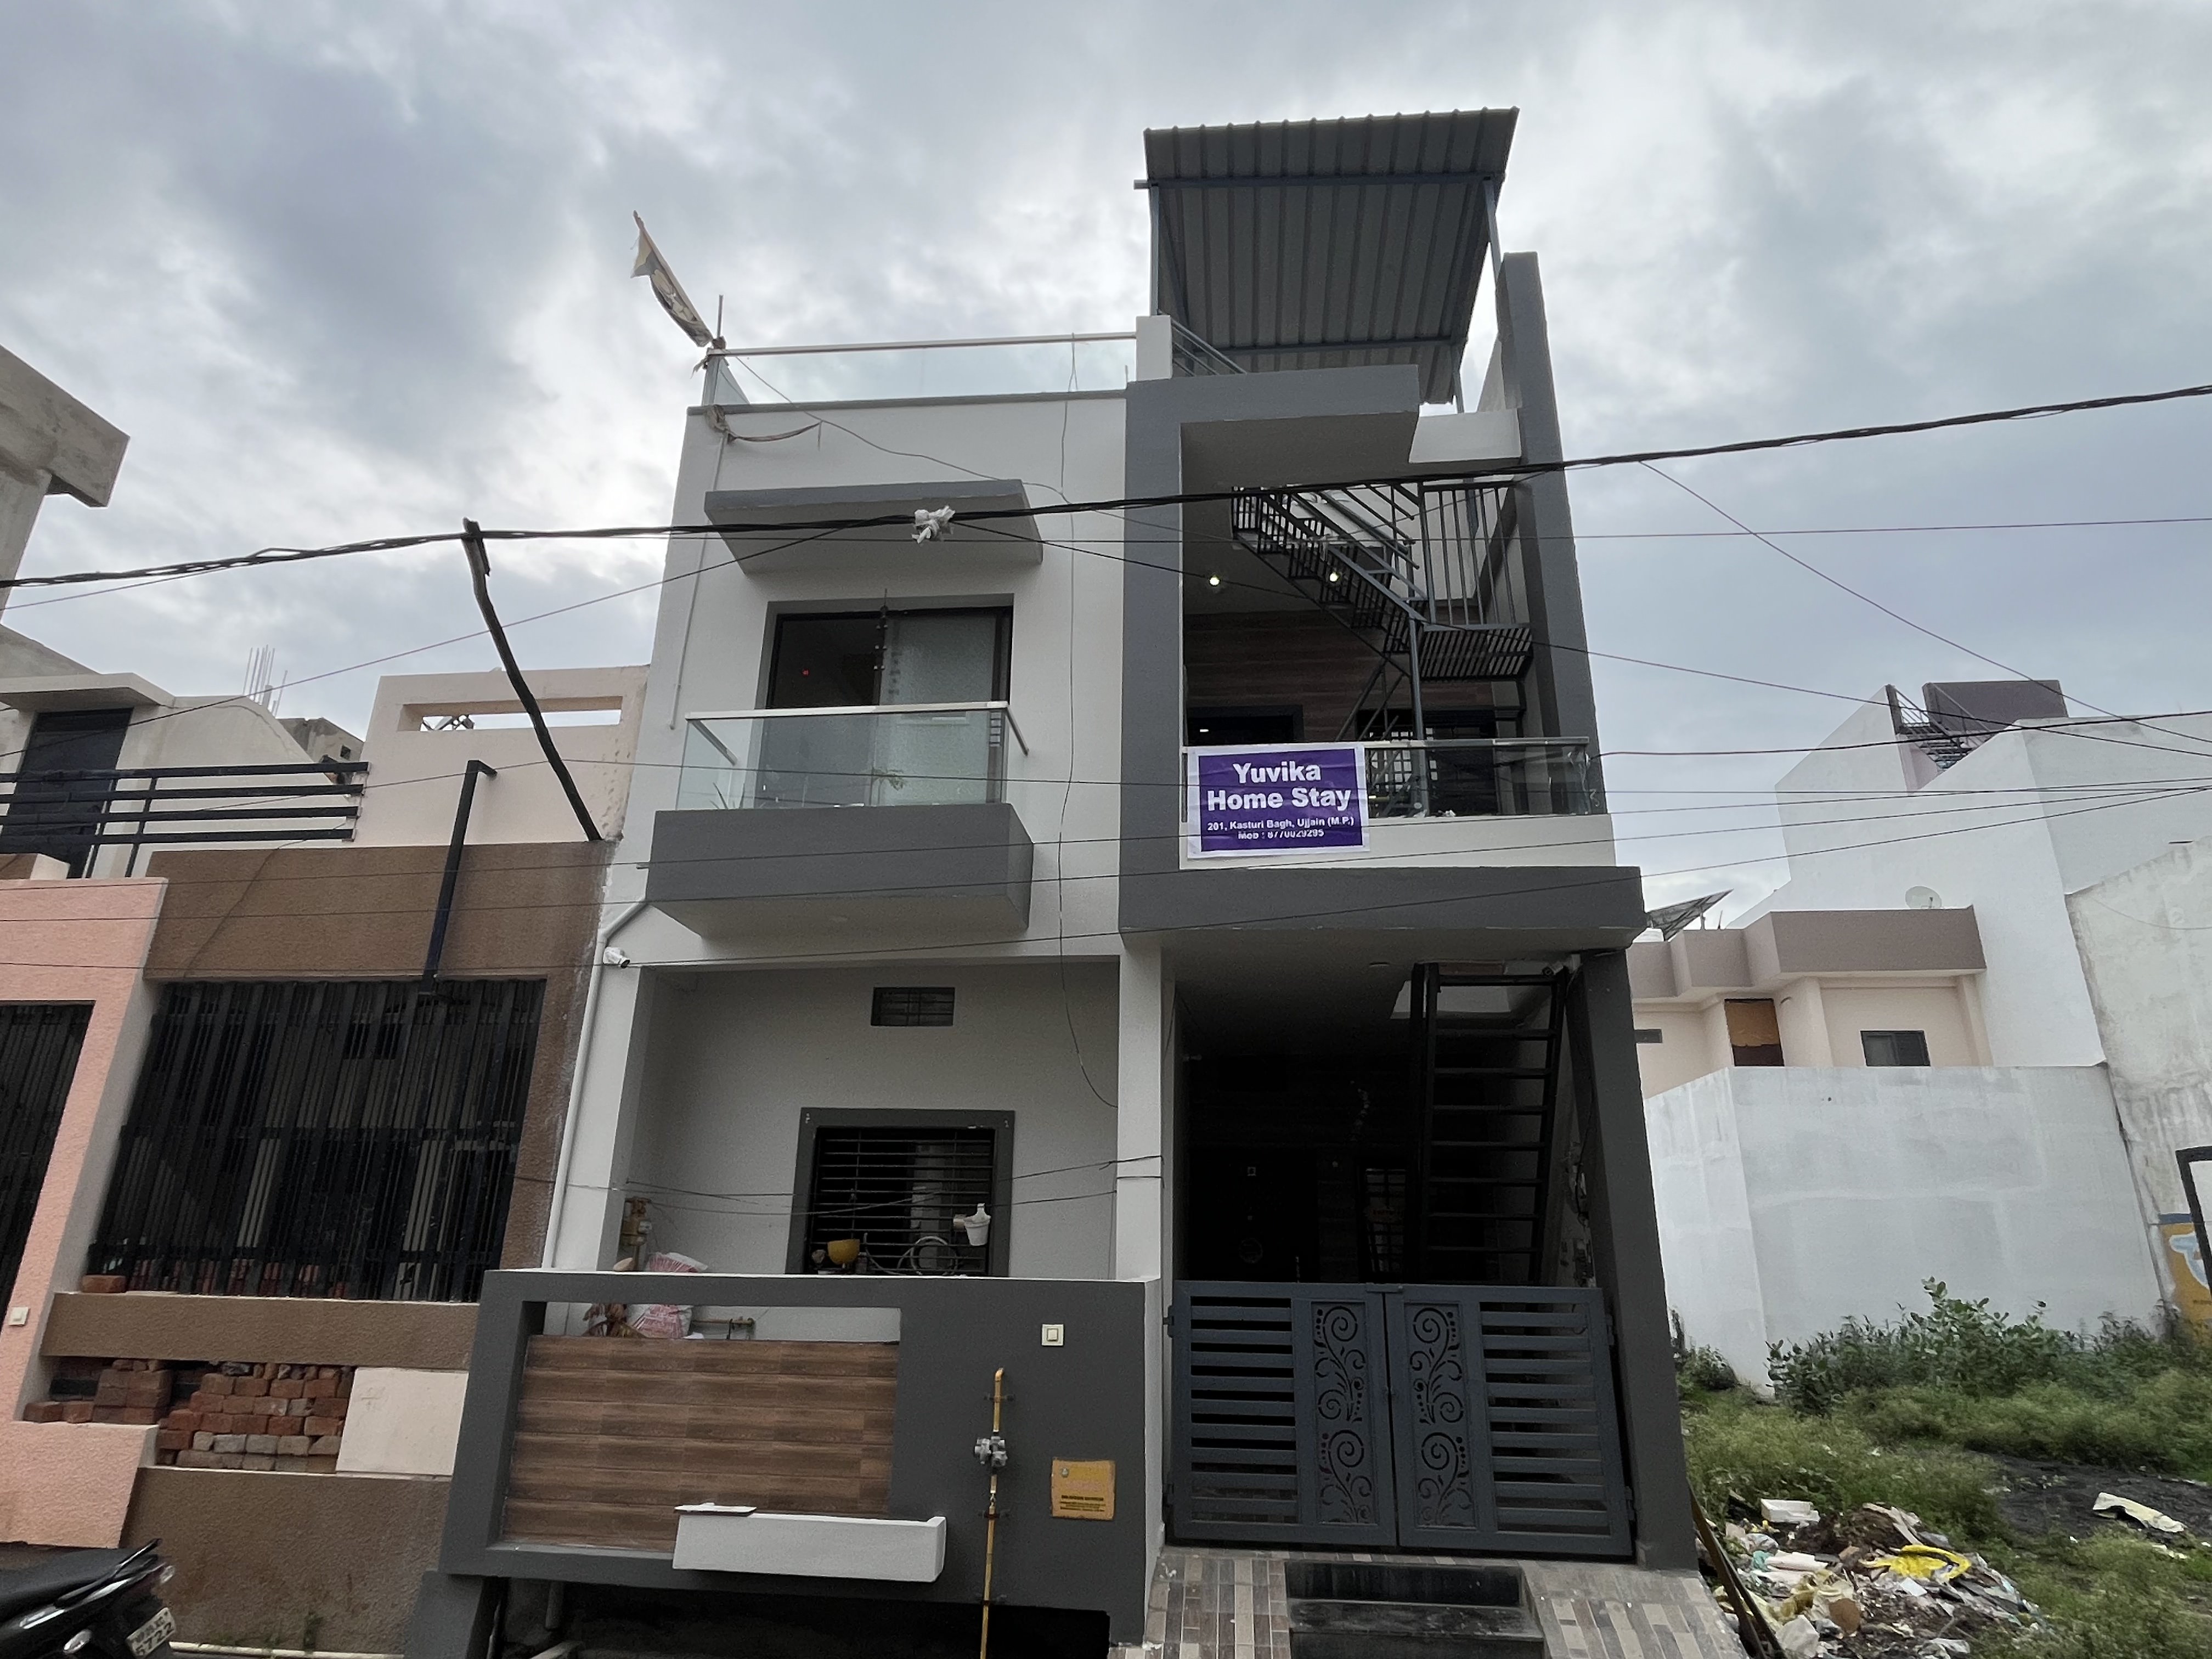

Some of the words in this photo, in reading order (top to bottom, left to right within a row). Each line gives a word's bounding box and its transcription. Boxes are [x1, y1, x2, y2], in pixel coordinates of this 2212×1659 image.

[1233, 761, 1321, 783] Yuvika
[1207, 790, 1284, 811] Home
[1291, 787, 1351, 811] Stay
[1229, 821, 1264, 830] Kasturi
[1297, 817, 1325, 828] Ujjain
